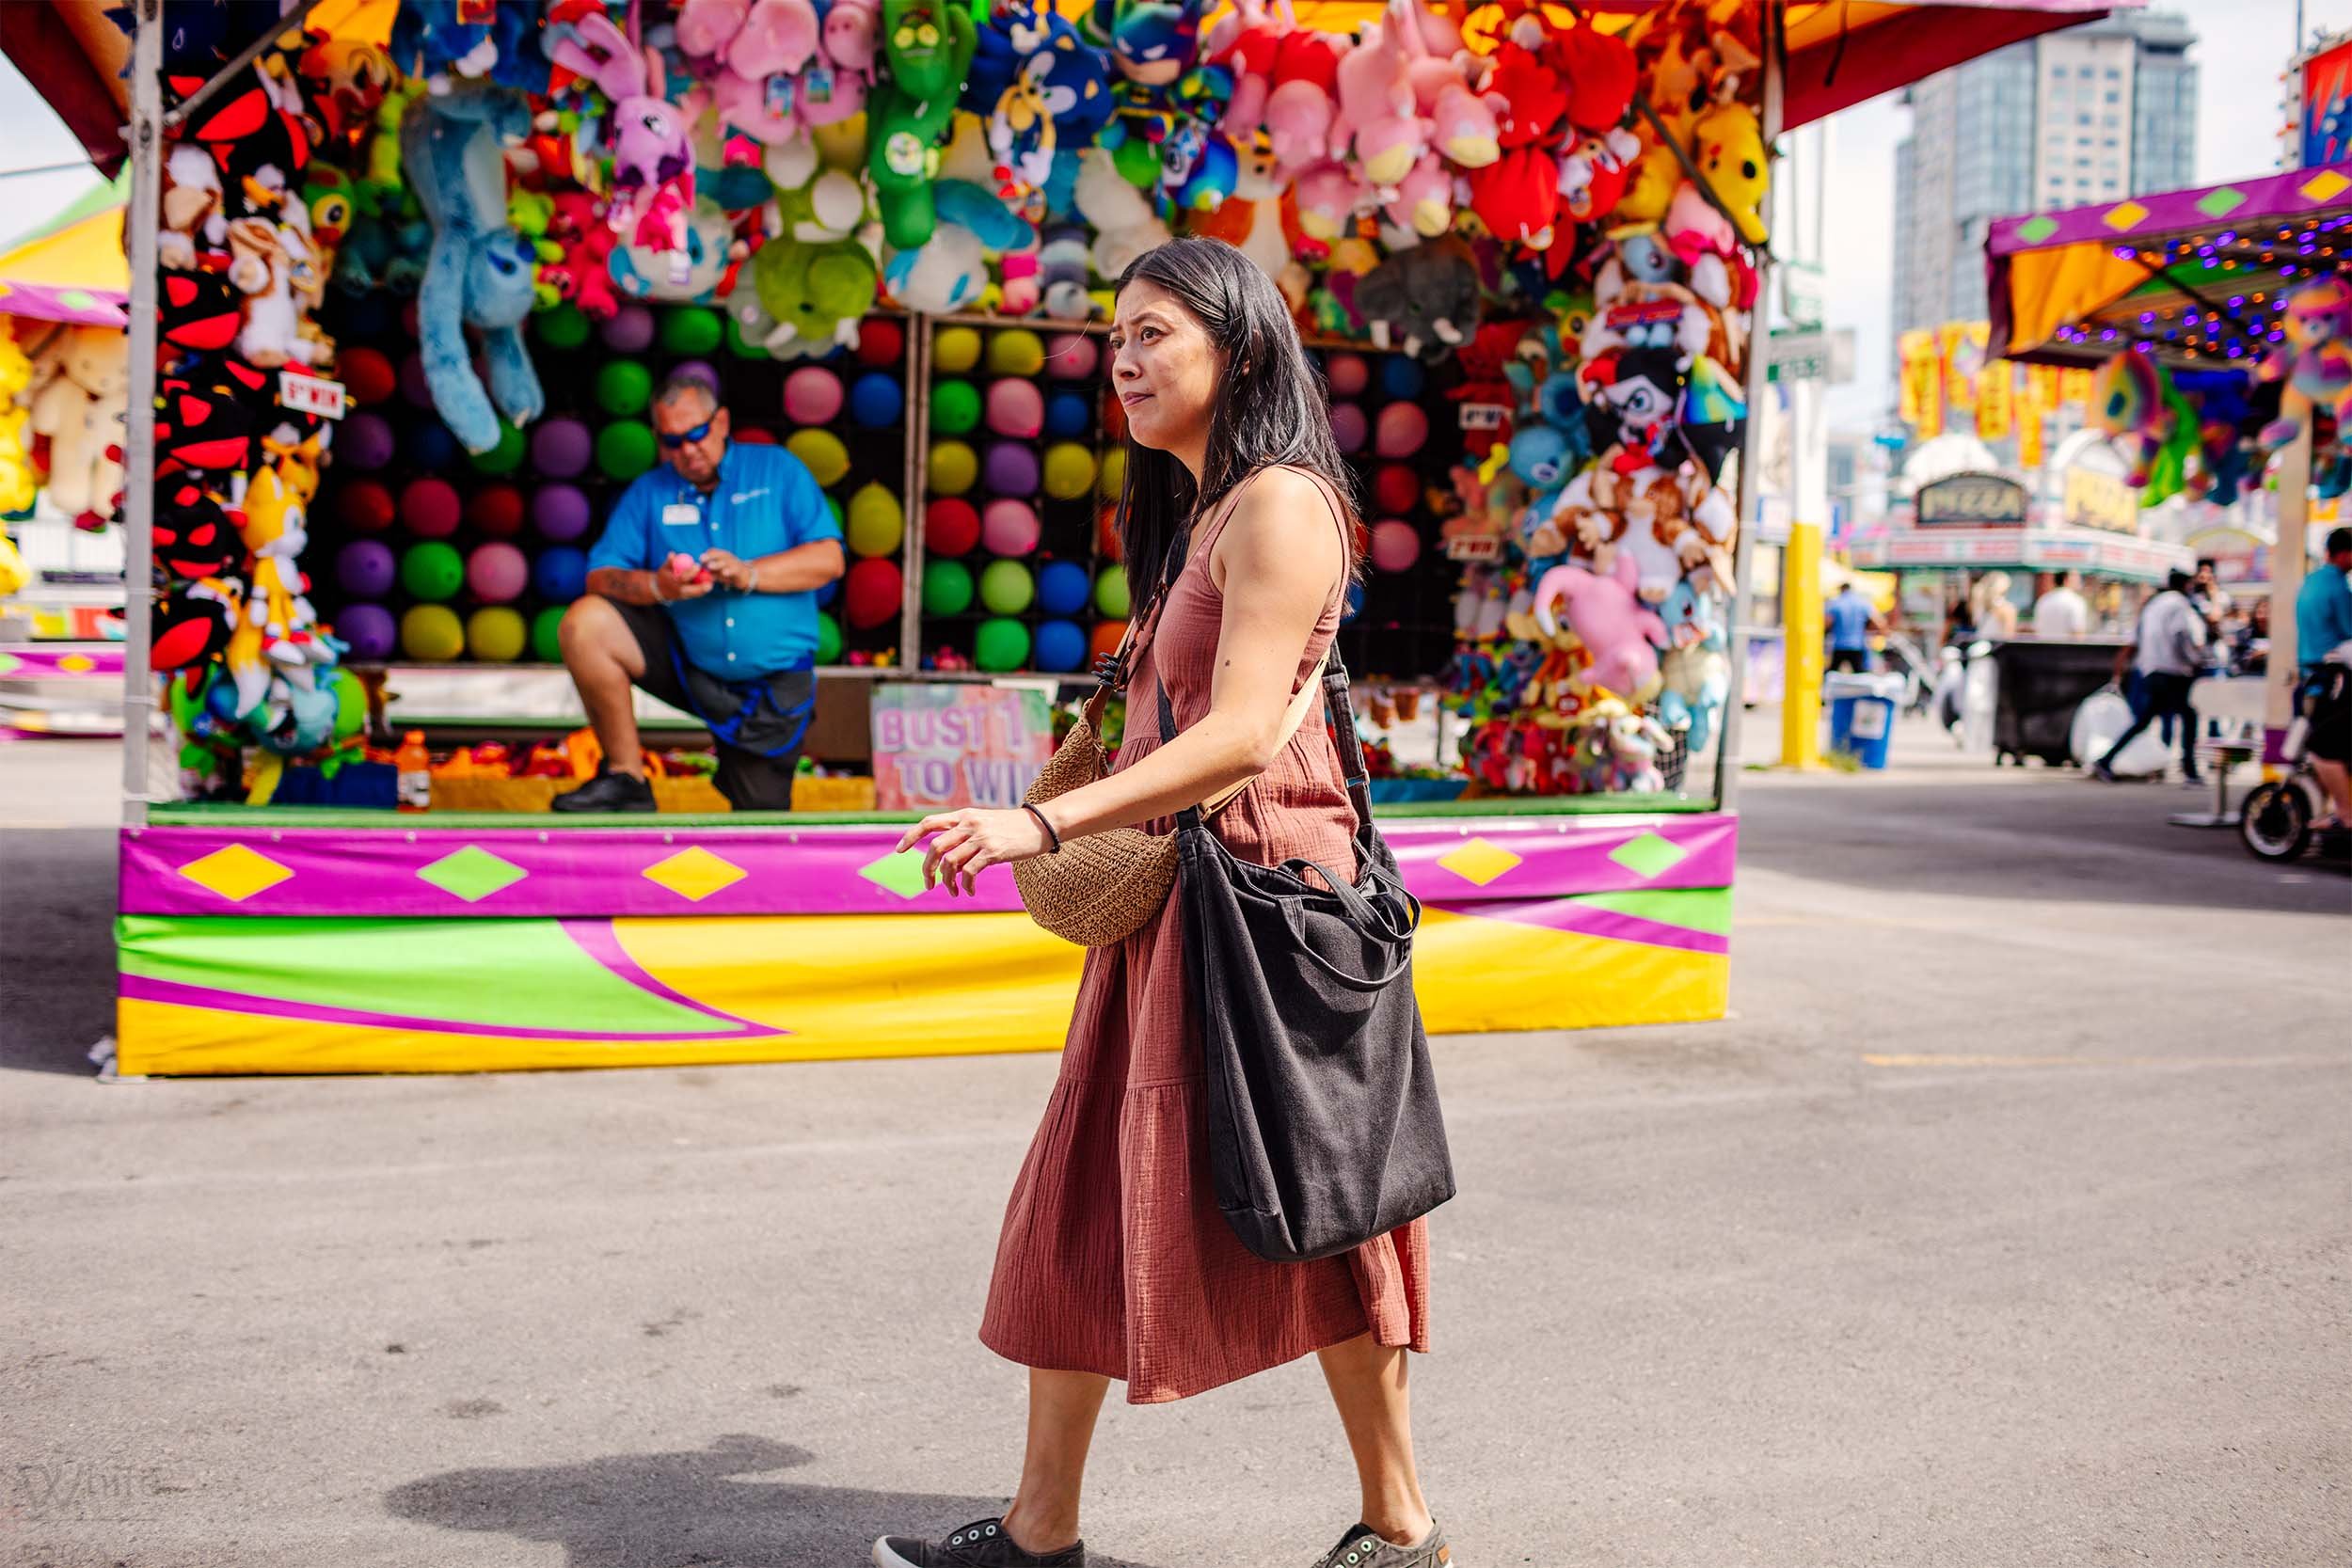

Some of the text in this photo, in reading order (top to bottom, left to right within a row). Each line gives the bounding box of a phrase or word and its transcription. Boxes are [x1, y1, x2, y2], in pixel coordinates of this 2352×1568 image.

[1922, 485, 2021, 520] PIZZA
[879, 692, 1024, 750] BUST 1
[894, 755, 954, 798] TO
